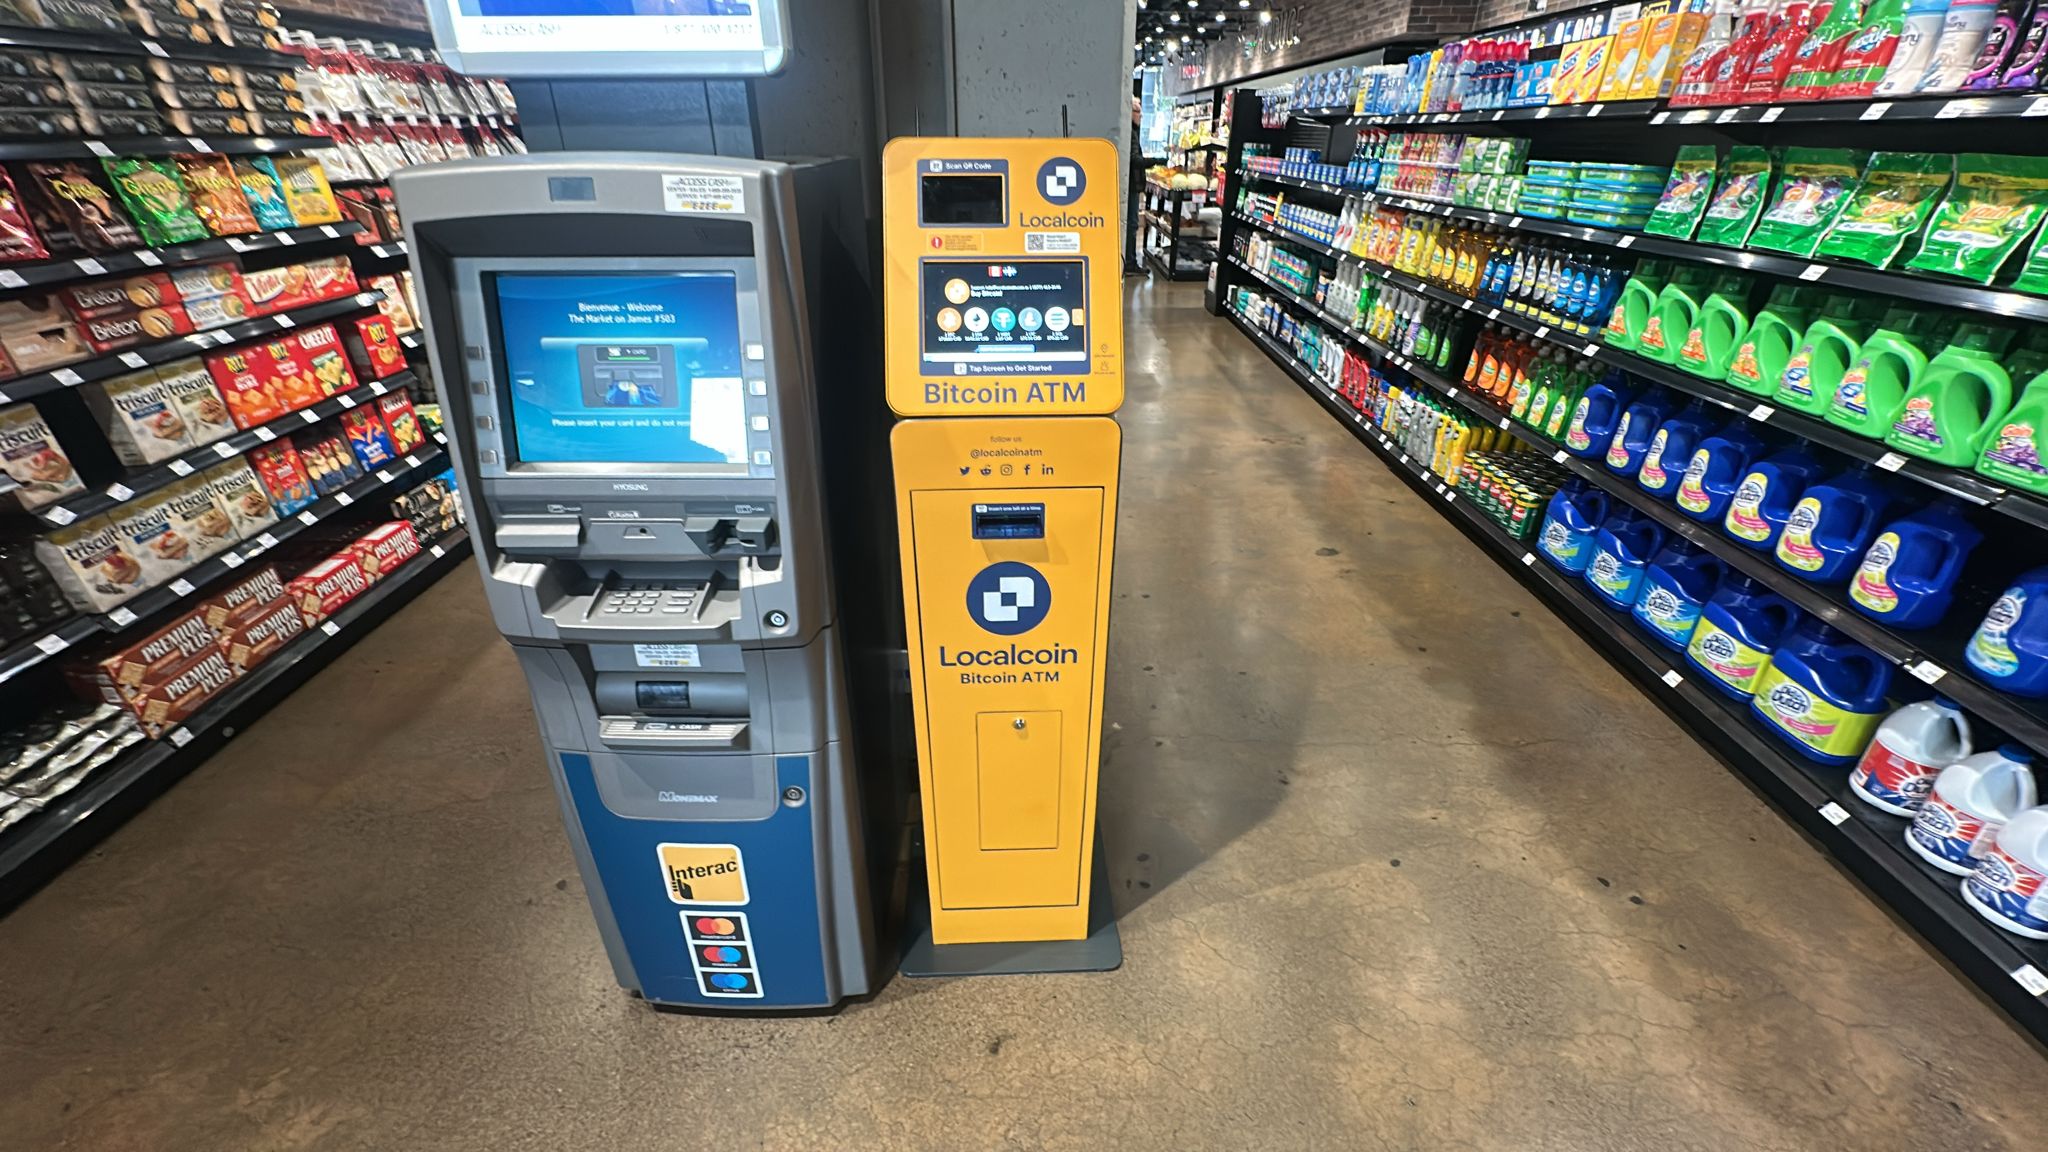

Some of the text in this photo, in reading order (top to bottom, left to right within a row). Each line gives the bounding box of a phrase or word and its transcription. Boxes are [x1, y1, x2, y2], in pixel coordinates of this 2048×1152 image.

[945, 162, 992, 170] Scan QR Code
[1019, 211, 1105, 228] Localcoin
[77, 285, 130, 309] Breton
[578, 302, 621, 313] Bienvenue
[627, 302, 664, 313] Welcome
[91, 318, 143, 342] Breton
[569, 313, 586, 324] The
[586, 313, 614, 325] Market
[616, 316, 627, 324] on
[627, 314, 653, 325] James
[969, 365, 982, 373] Tap
[166, 372, 213, 397] triscuit
[924, 382, 1086, 404] Bitcoin ATM
[115, 385, 168, 412] triscuit
[552, 418, 576, 427] Please
[576, 418, 599, 428] insert
[600, 419, 617, 429] your
[617, 418, 634, 427] card
[635, 418, 651, 427] and
[651, 418, 661, 427] do
[662, 419, 677, 427] not
[990, 435, 1012, 443] follow
[970, 448, 1043, 459] @localcoinatm
[215, 466, 255, 495] triscuit
[168, 484, 215, 515] triscuit
[121, 504, 172, 535] triscuit
[65, 526, 121, 561] triscuit
[374, 526, 413, 560] PREMIUM
[396, 538, 418, 560] PLUS
[223, 566, 279, 608] PREMIUM
[314, 562, 360, 599] PREMIUM
[340, 573, 366, 598] PLUS
[258, 583, 284, 606] PLUS
[246, 602, 297, 646] PREMIUM
[274, 614, 303, 643] PLUS
[140, 614, 208, 664] PREMIUM
[179, 627, 216, 658] PLUS
[939, 642, 1079, 667] Localcoin
[164, 651, 229, 701] PREMIUM
[199, 664, 234, 695] PLUS
[960, 671, 1060, 685] Bitcoin ATM
[668, 860, 739, 881] Interac
